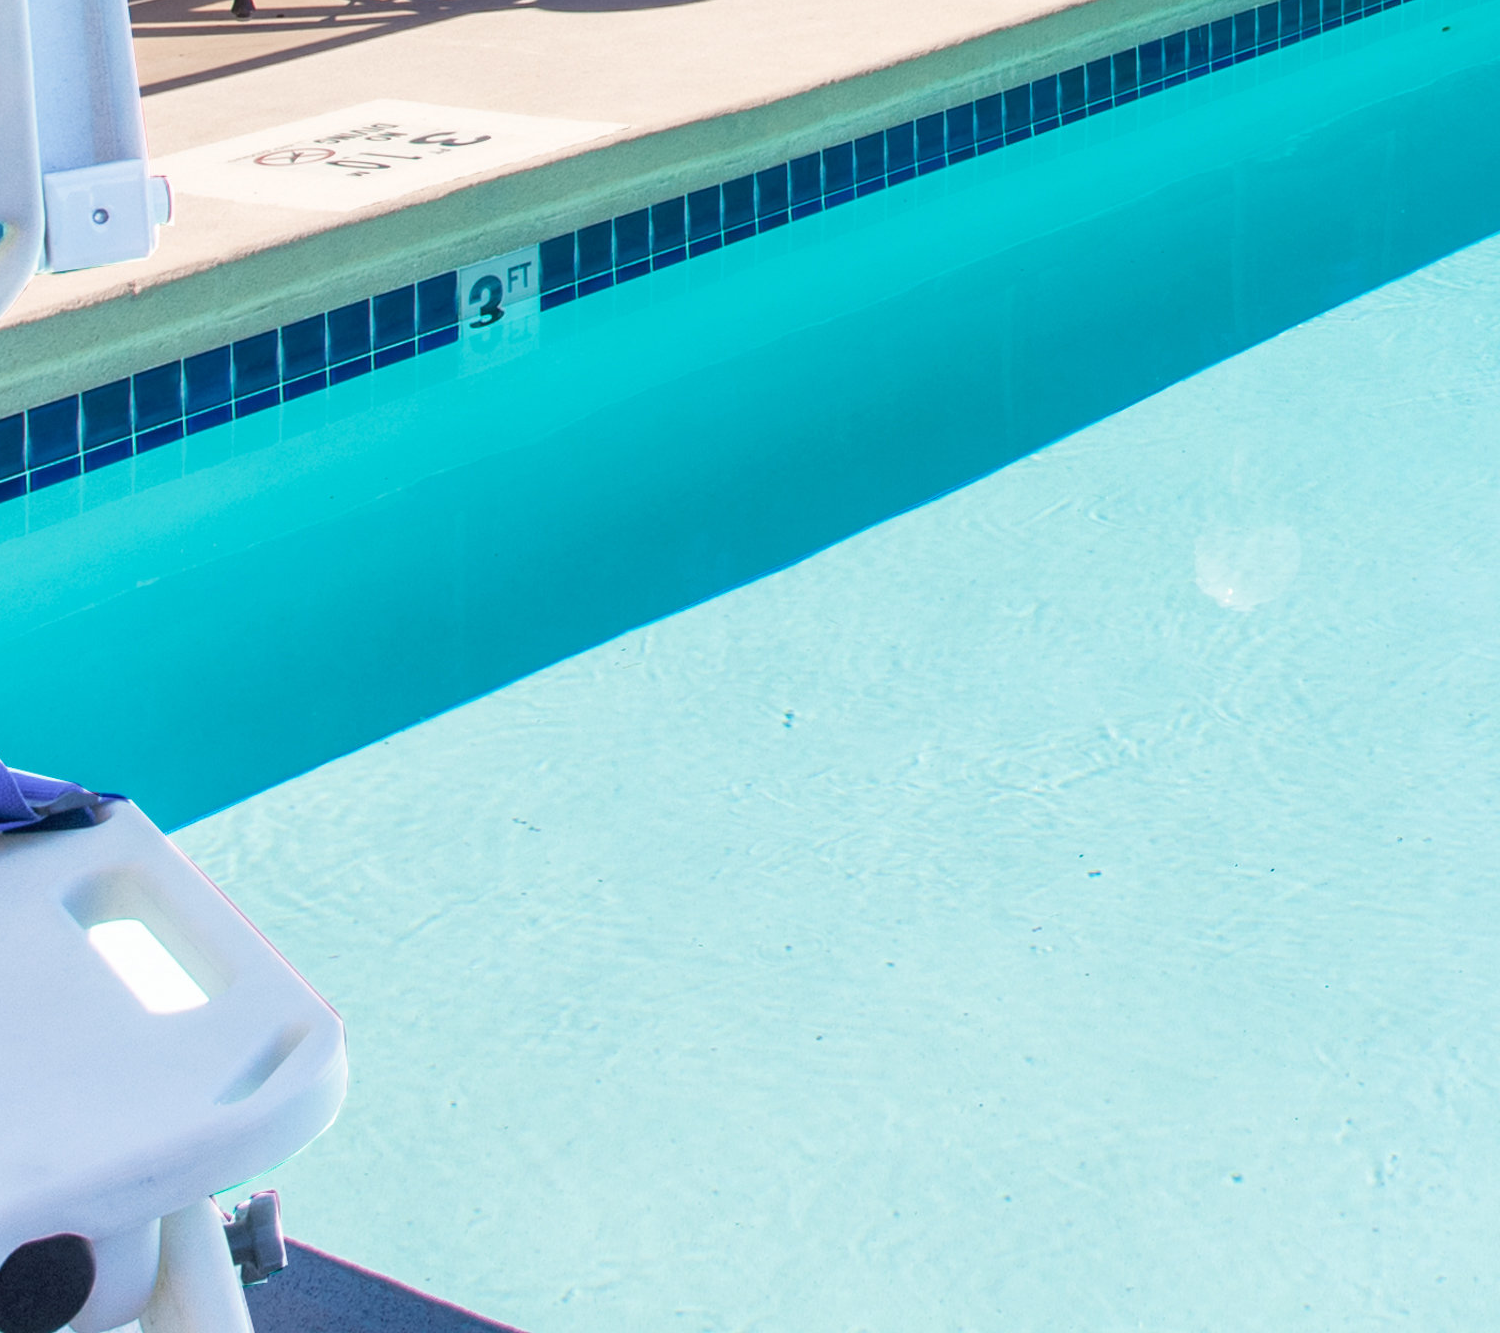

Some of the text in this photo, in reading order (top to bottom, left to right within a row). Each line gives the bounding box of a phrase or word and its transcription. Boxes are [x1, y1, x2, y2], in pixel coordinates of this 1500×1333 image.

[409, 131, 492, 147] 3
[468, 260, 532, 329] 3 FT
